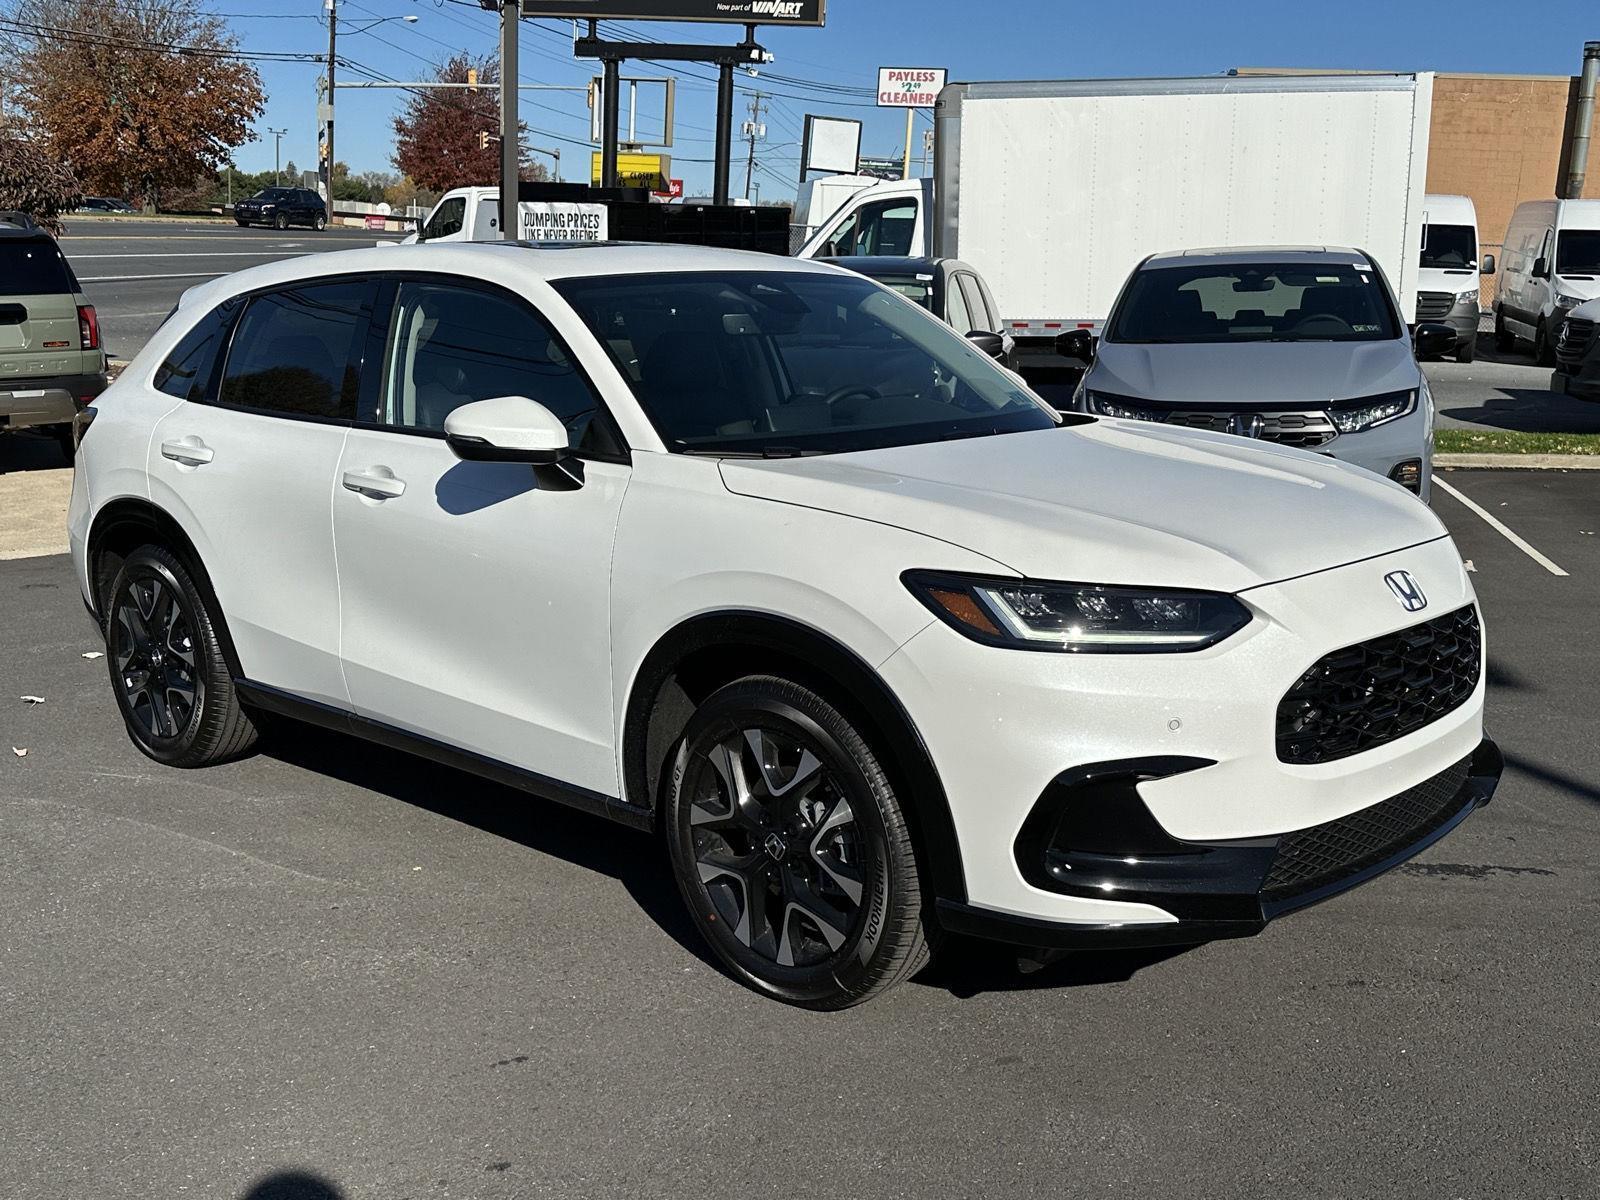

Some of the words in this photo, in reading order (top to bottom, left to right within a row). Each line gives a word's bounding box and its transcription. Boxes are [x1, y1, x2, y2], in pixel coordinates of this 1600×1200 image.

[716, 3, 730, 11] Now
[730, 4, 744, 12] part
[744, 3, 752, 11] of
[752, 0, 804, 17] VINART
[888, 71, 936, 82] PAYLESS
[880, 91, 938, 105] CLEANER
[524, 212, 566, 228] DUMPING
[567, 212, 600, 229] PRICES
